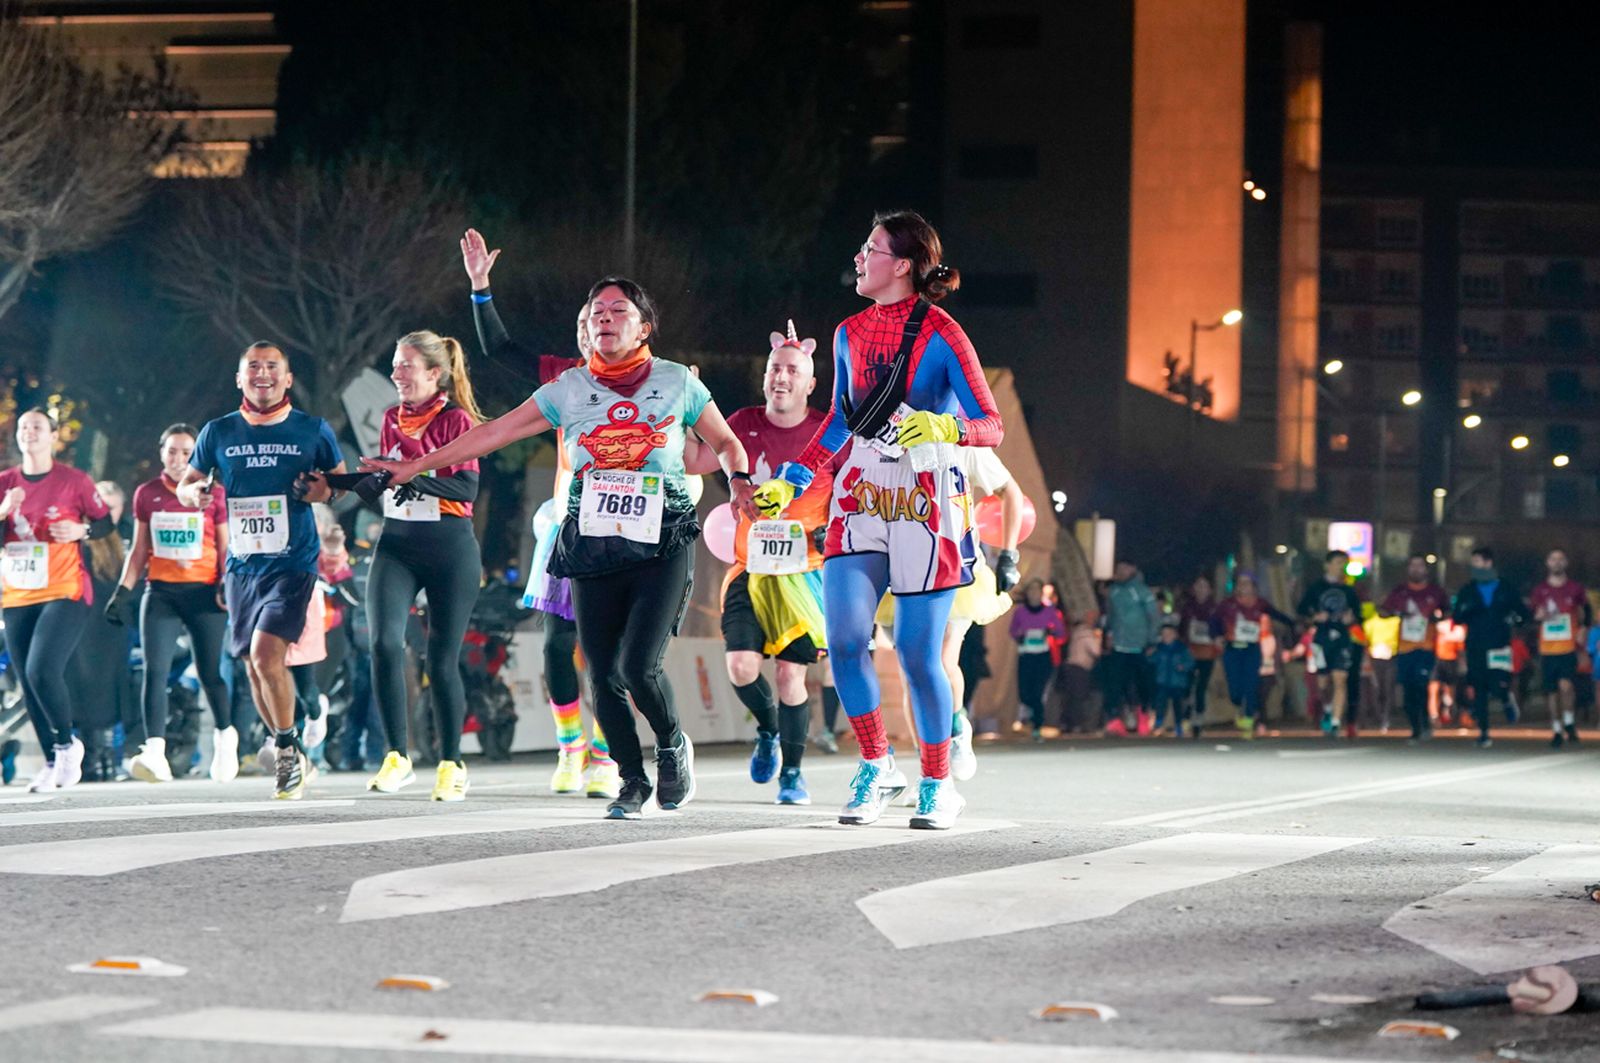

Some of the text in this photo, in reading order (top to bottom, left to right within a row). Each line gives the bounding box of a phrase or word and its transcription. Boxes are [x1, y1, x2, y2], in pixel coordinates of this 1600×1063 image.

[257, 443, 301, 455] RURAL
[592, 482, 608, 491] SAN
[602, 474, 625, 484] NOCHE
[626, 476, 636, 485] DE
[596, 492, 647, 517] 7689
[241, 517, 275, 534] 2073
[158, 530, 196, 544] 13739
[760, 539, 793, 556] 7077
